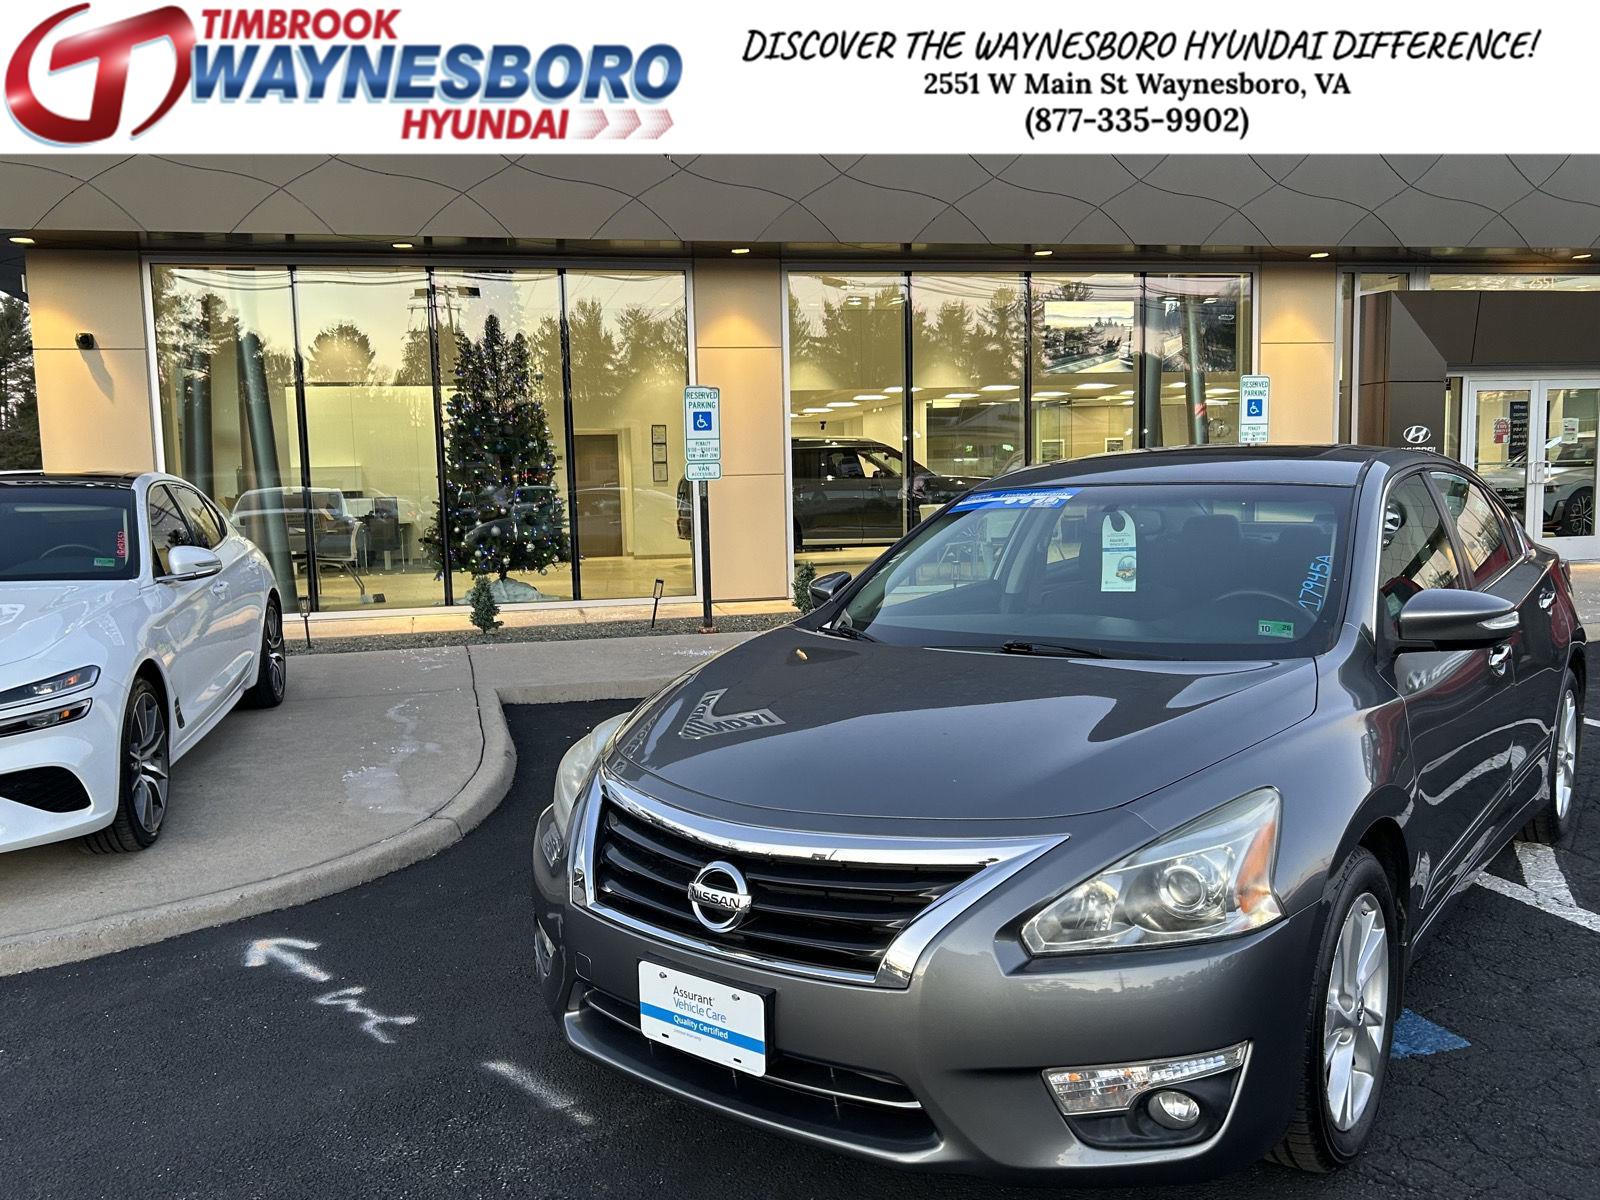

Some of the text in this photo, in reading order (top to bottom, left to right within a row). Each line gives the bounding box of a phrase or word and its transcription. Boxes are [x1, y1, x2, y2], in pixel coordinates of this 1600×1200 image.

[686, 391, 717, 400] RESERVED
[1243, 389, 1266, 397] PARKING
[688, 401, 716, 409] PARKING
[1298, 554, 1333, 612] 17945A
[691, 886, 741, 910] NISSAN
[673, 985, 714, 1007] Assurant
[673, 997, 727, 1024] Vehicle Care
[673, 1014, 729, 1040] Quality Certified
